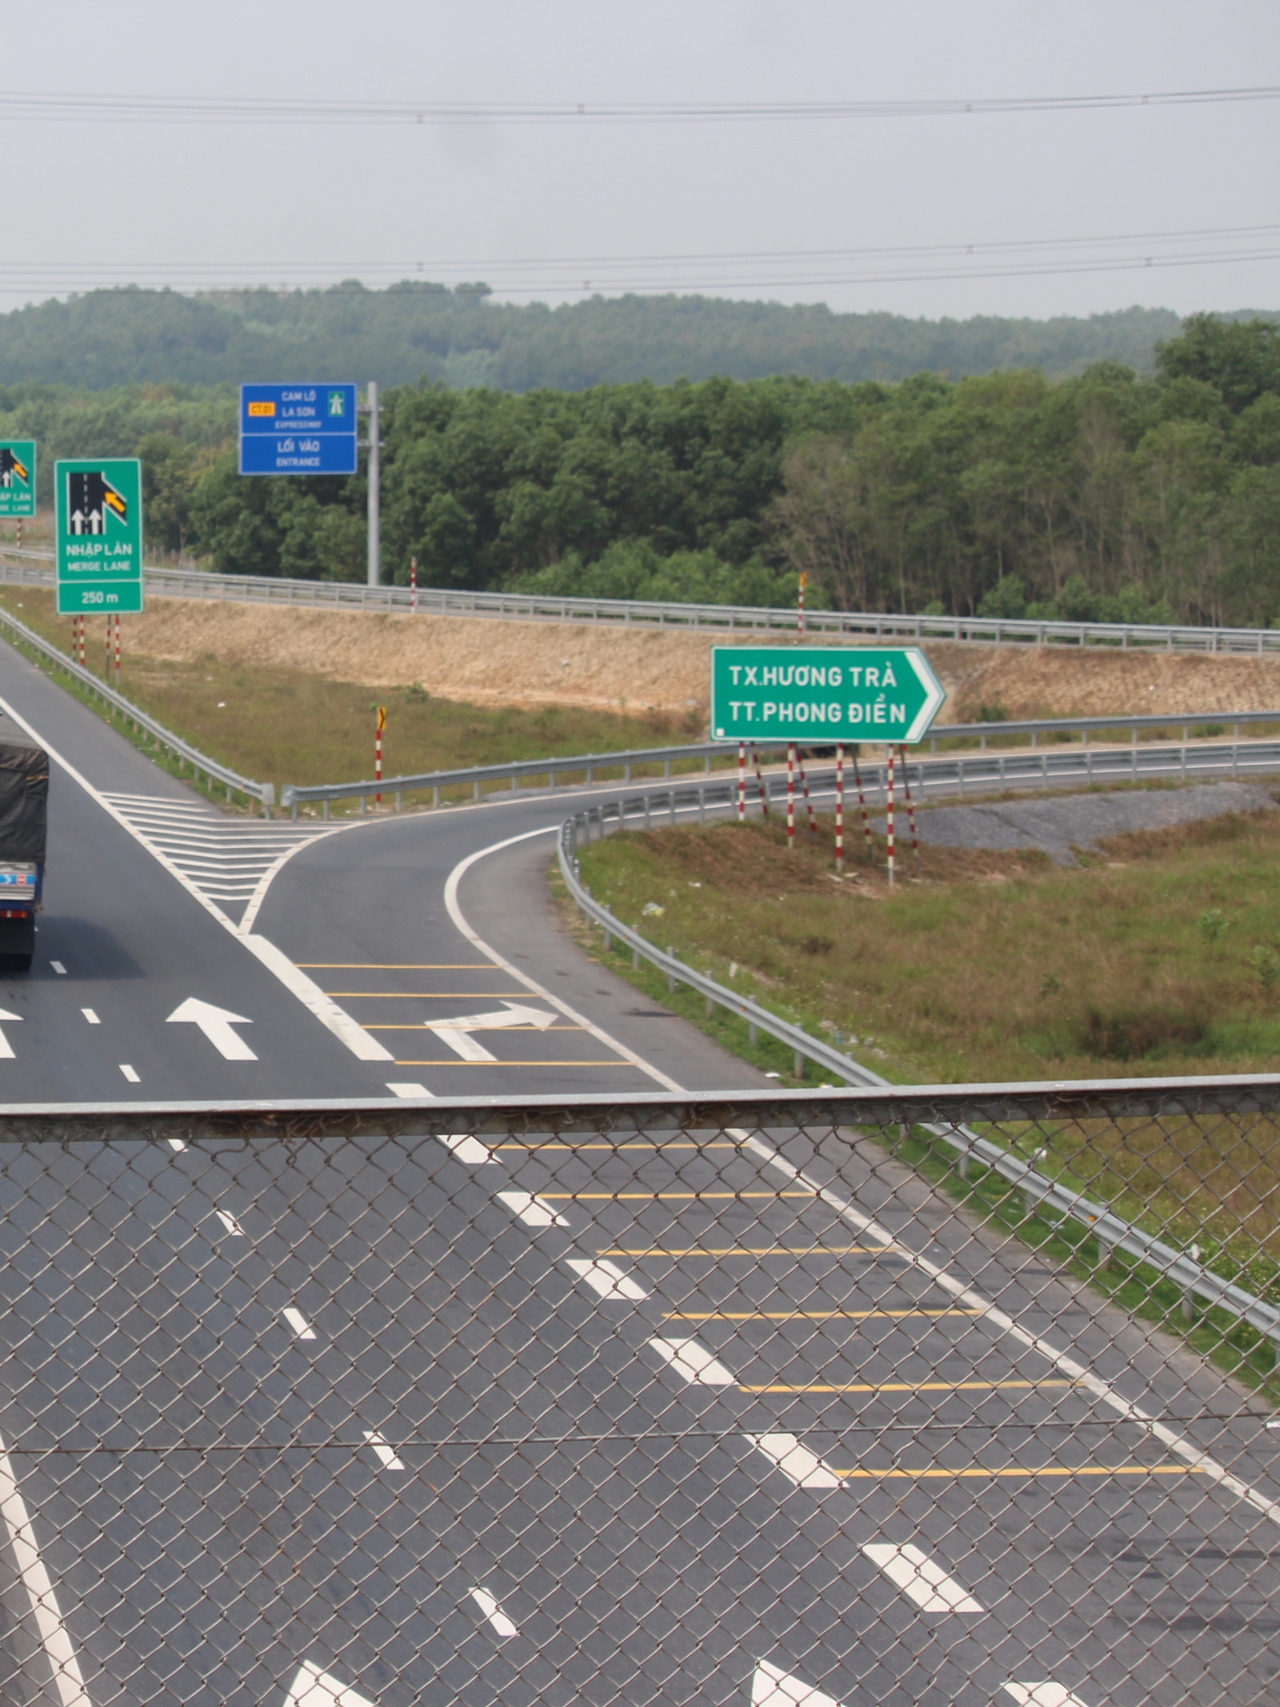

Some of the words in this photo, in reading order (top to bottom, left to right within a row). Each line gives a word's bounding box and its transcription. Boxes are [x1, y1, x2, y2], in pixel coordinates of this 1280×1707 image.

[281, 391, 302, 402] CAM
[281, 407, 295, 418] LA
[274, 421, 322, 430] EXPRESSWAY
[277, 437, 295, 453] LỐI
[298, 438, 321, 453] VÀO
[276, 457, 321, 467] ENTRANCE
[66, 541, 102, 558] NHẬP
[104, 540, 133, 556] LÀN
[68, 561, 101, 572] MERGE
[103, 561, 131, 572] LANE
[82, 591, 104, 604] 250
[106, 593, 119, 603] m
[729, 664, 843, 687] TX.HƯƠNG
[848, 661, 898, 687] TRÀ
[729, 701, 842, 723] TT.PHONG
[847, 693, 906, 724] ĐIỀN
